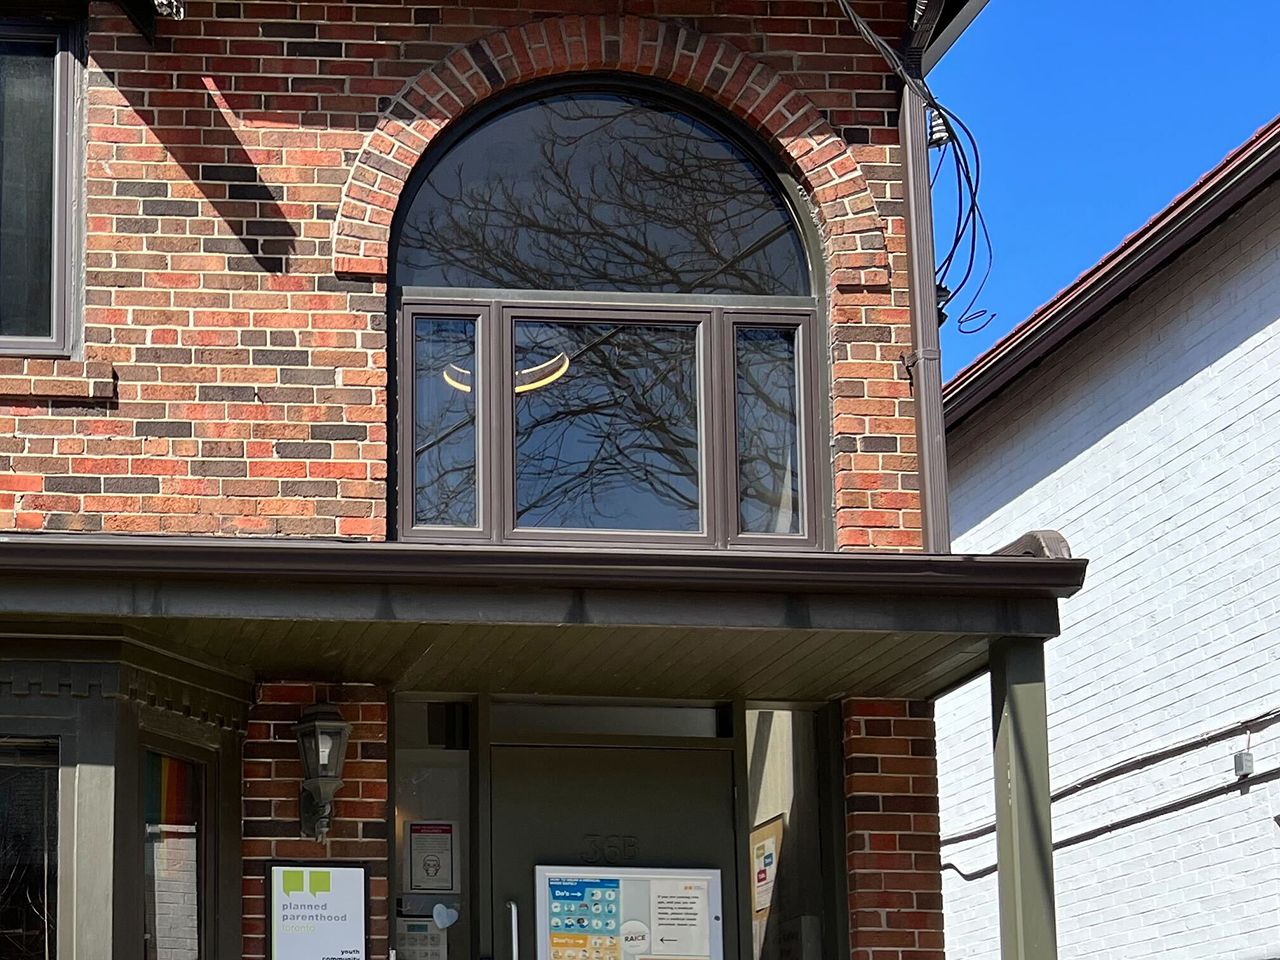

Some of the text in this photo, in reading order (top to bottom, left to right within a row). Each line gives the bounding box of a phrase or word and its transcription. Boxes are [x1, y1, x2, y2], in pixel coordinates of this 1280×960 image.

[282, 902, 327, 911] planned
[282, 913, 347, 922] parenthood
[282, 924, 315, 932] toronto
